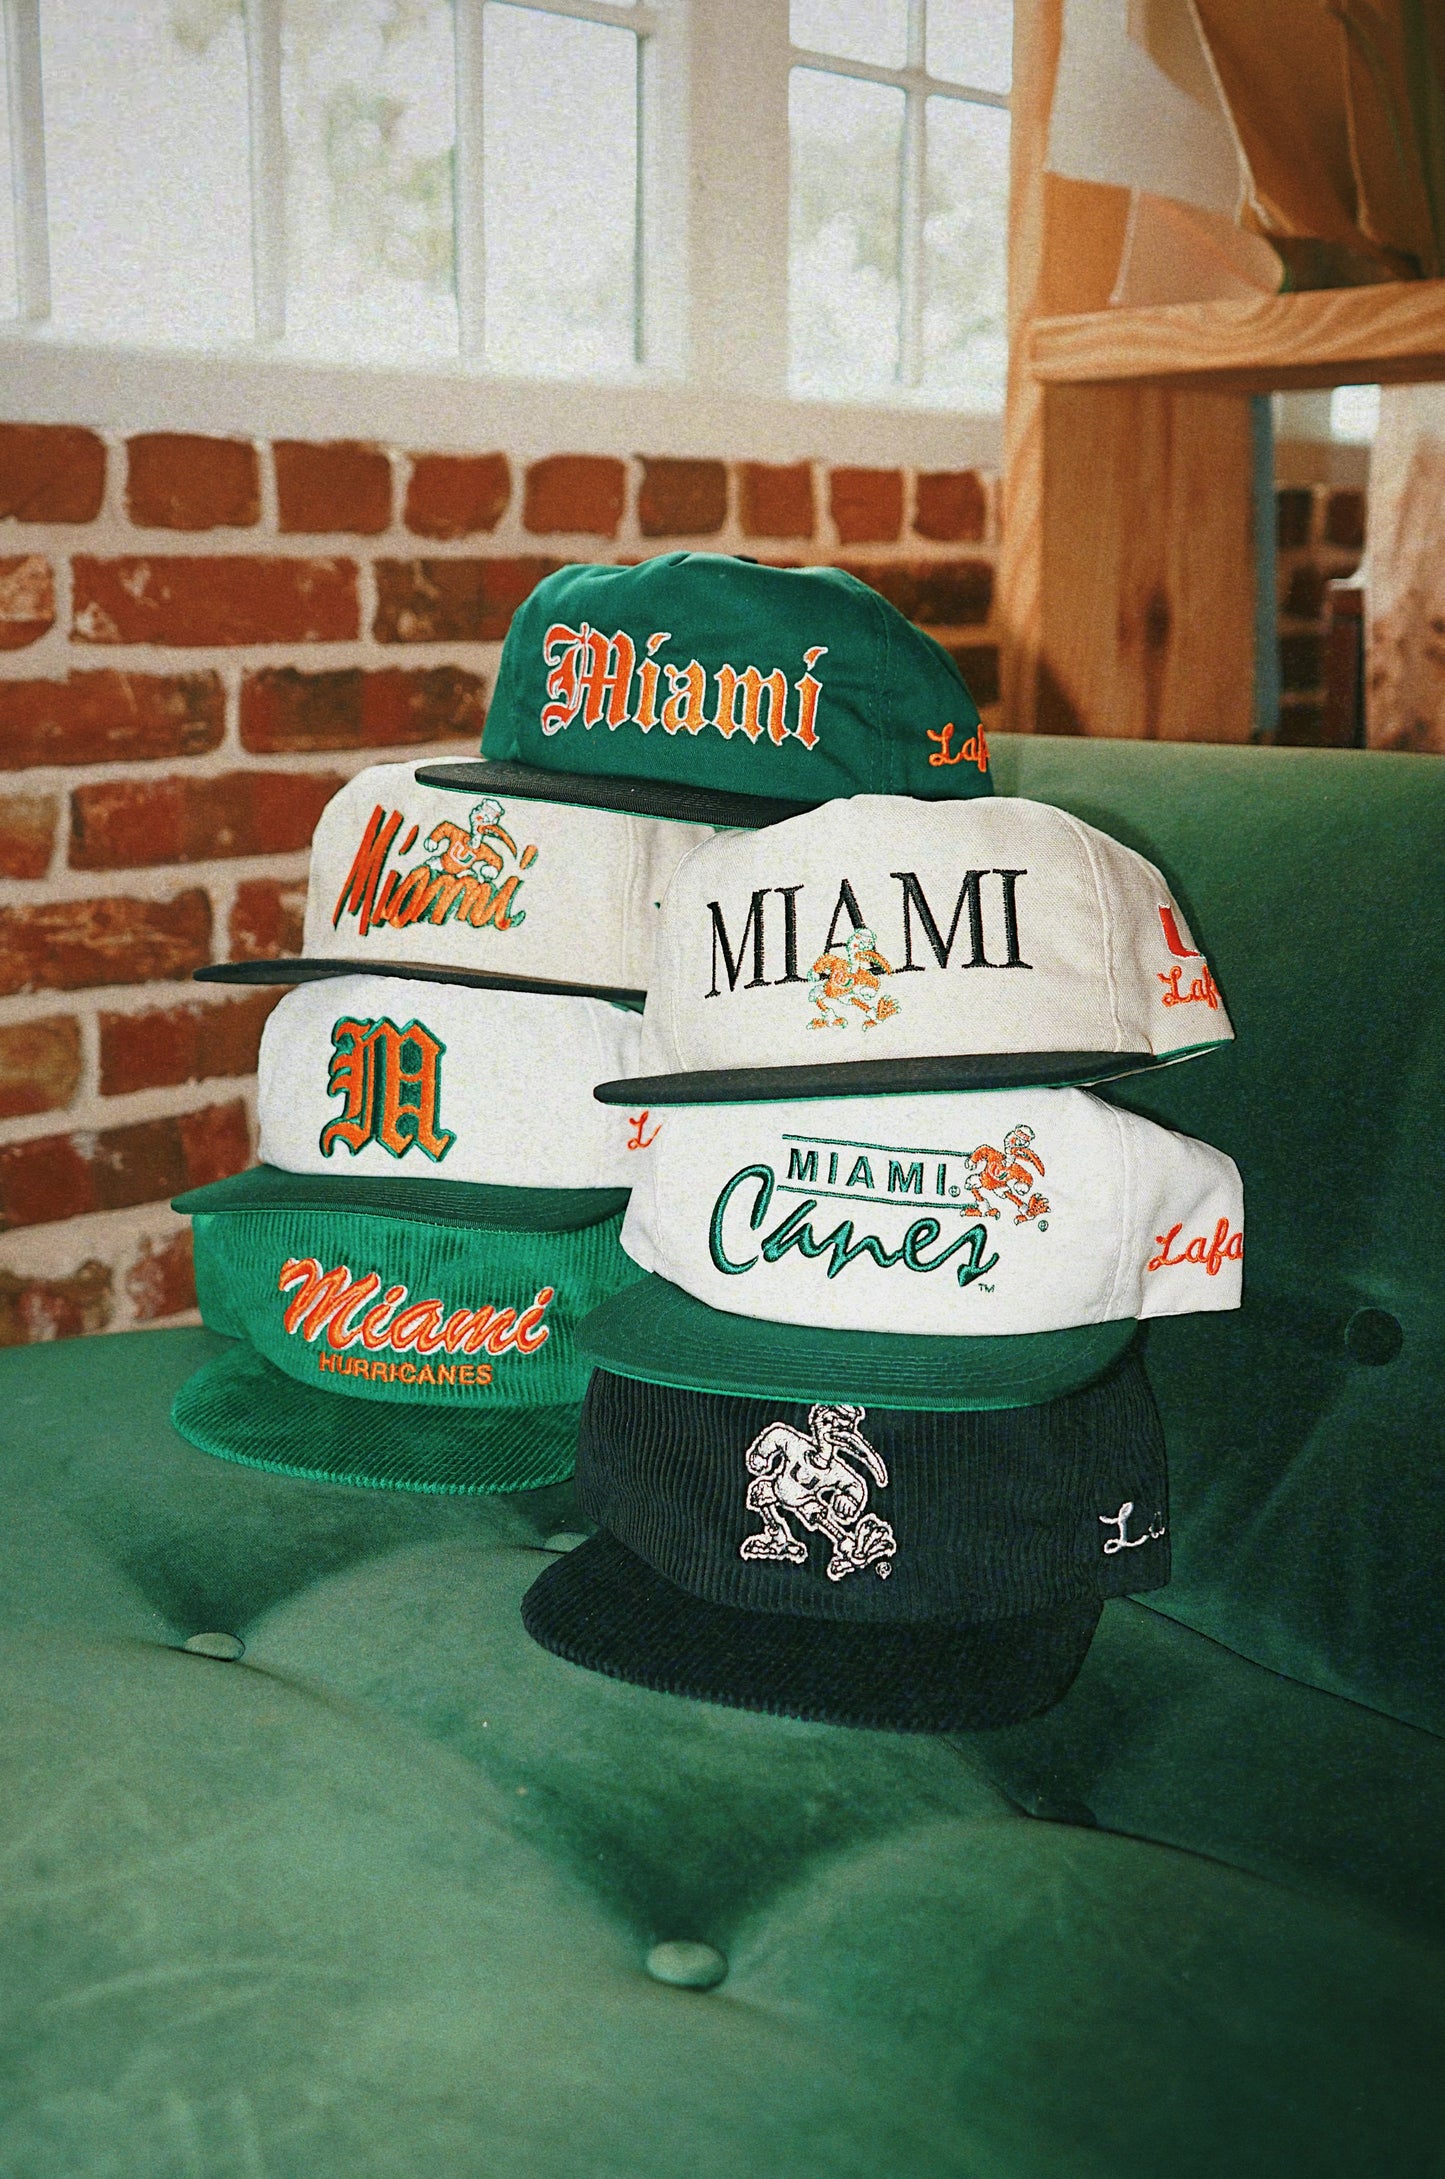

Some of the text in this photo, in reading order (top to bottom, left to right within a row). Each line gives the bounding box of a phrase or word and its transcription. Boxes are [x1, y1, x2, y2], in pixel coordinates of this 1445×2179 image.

[540, 622, 829, 750] Miami
[332, 804, 538, 937] Miami
[704, 869, 1033, 999] MIAMI
[319, 1016, 457, 1163] M
[708, 1163, 1000, 1287] Canes
[786, 1147, 948, 1196] MIAMI
[278, 1256, 555, 1356] Miami
[1147, 1216, 1244, 1276] Lafa
[318, 1351, 494, 1386] HURRICANES
